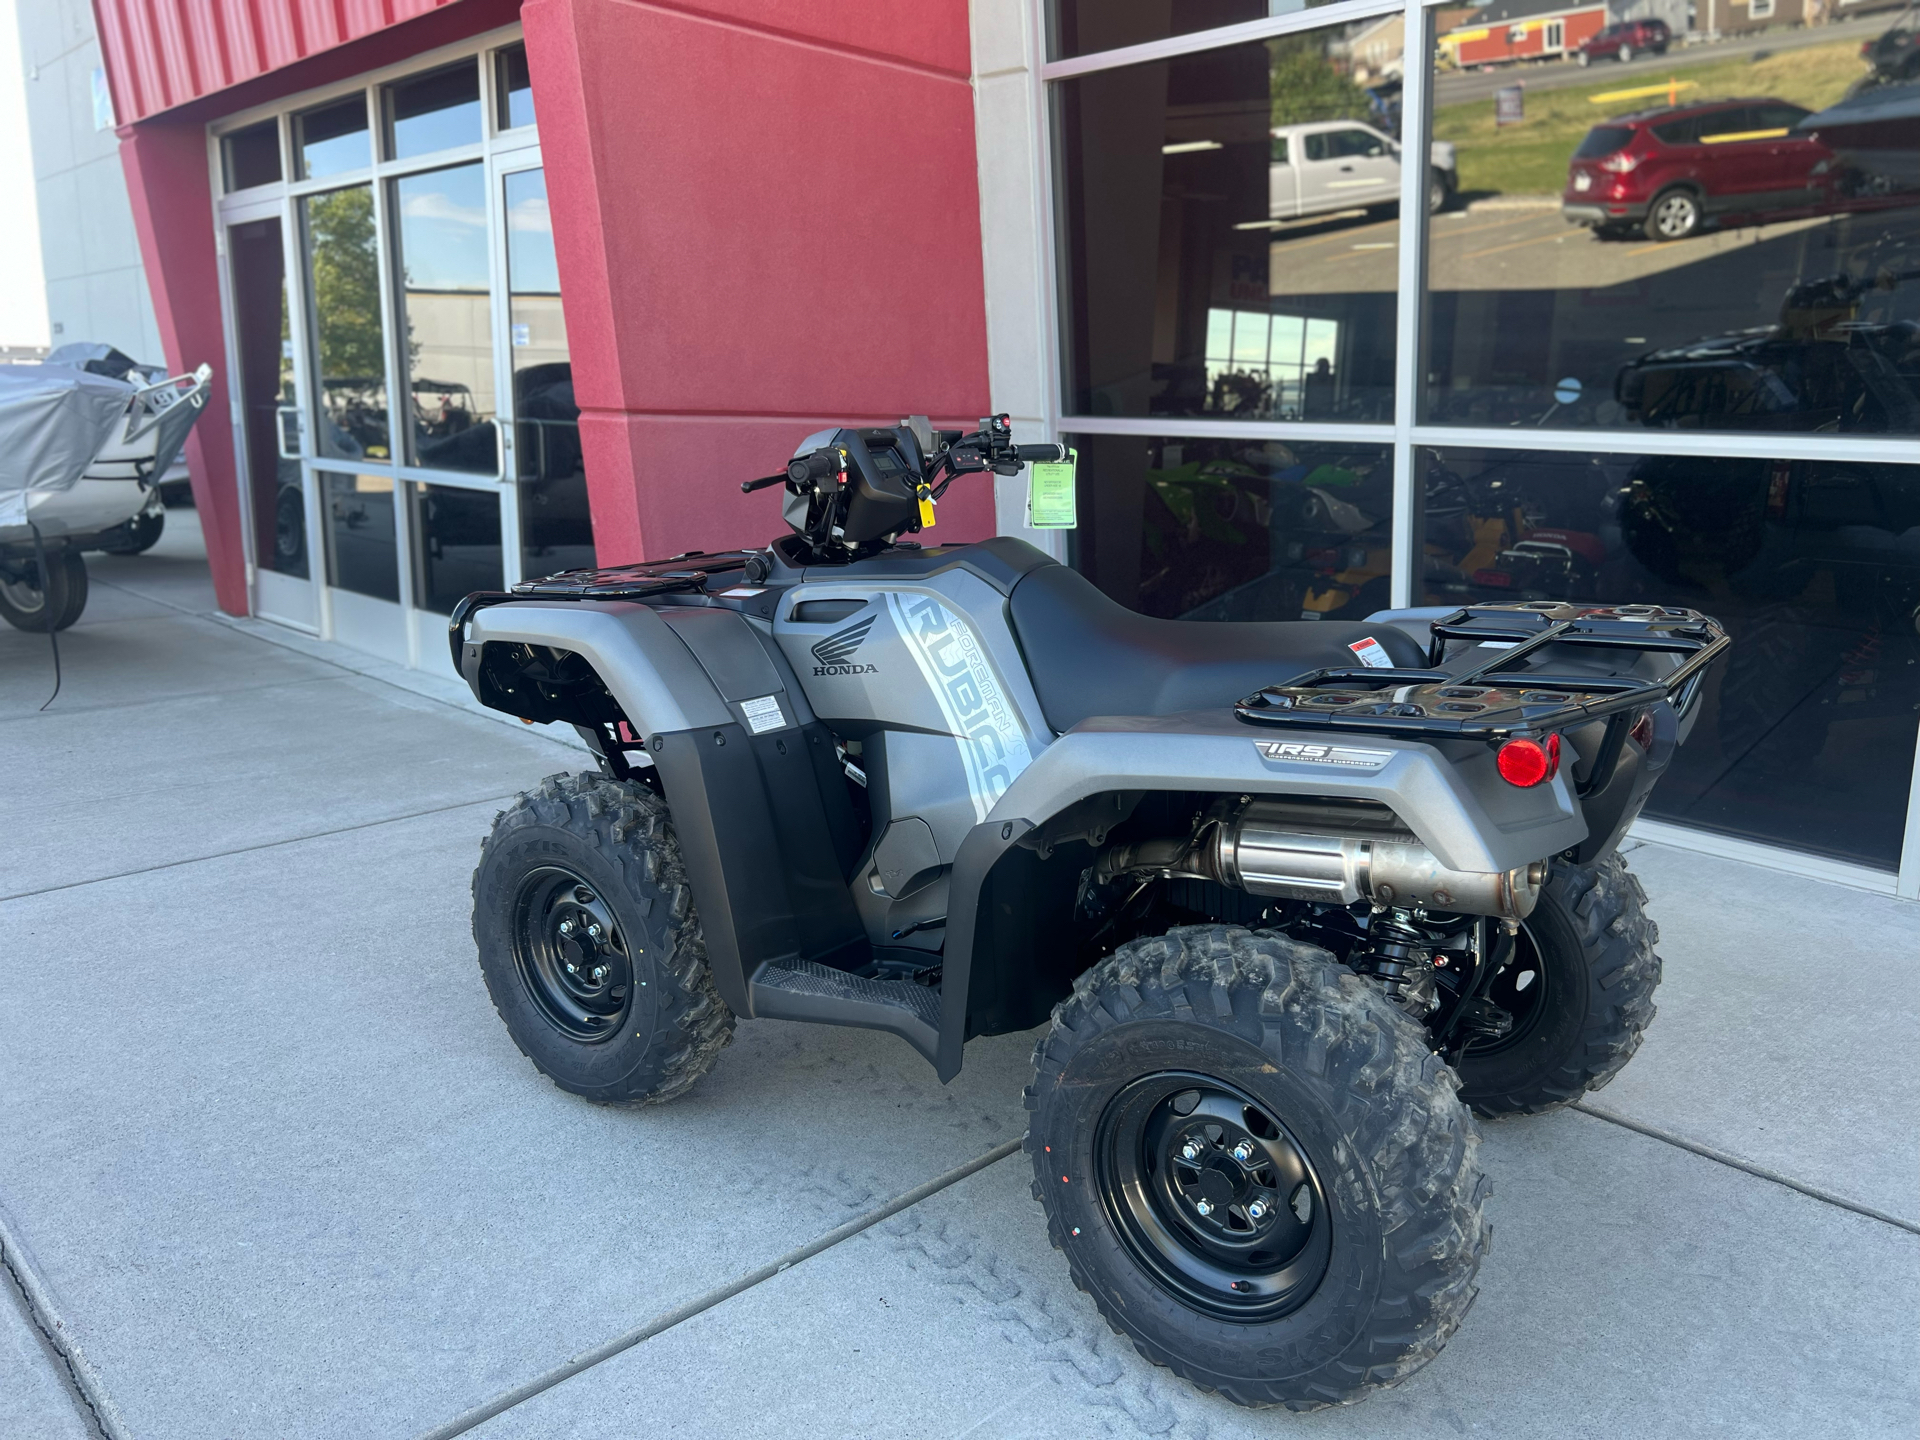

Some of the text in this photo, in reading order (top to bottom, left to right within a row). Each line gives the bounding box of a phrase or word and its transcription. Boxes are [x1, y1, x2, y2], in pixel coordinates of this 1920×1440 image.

[1532, 532, 1567, 540] HONDA
[813, 664, 879, 676] HONDA
[950, 619, 1012, 731] FOREMAN
[1268, 743, 1327, 757] IRS
